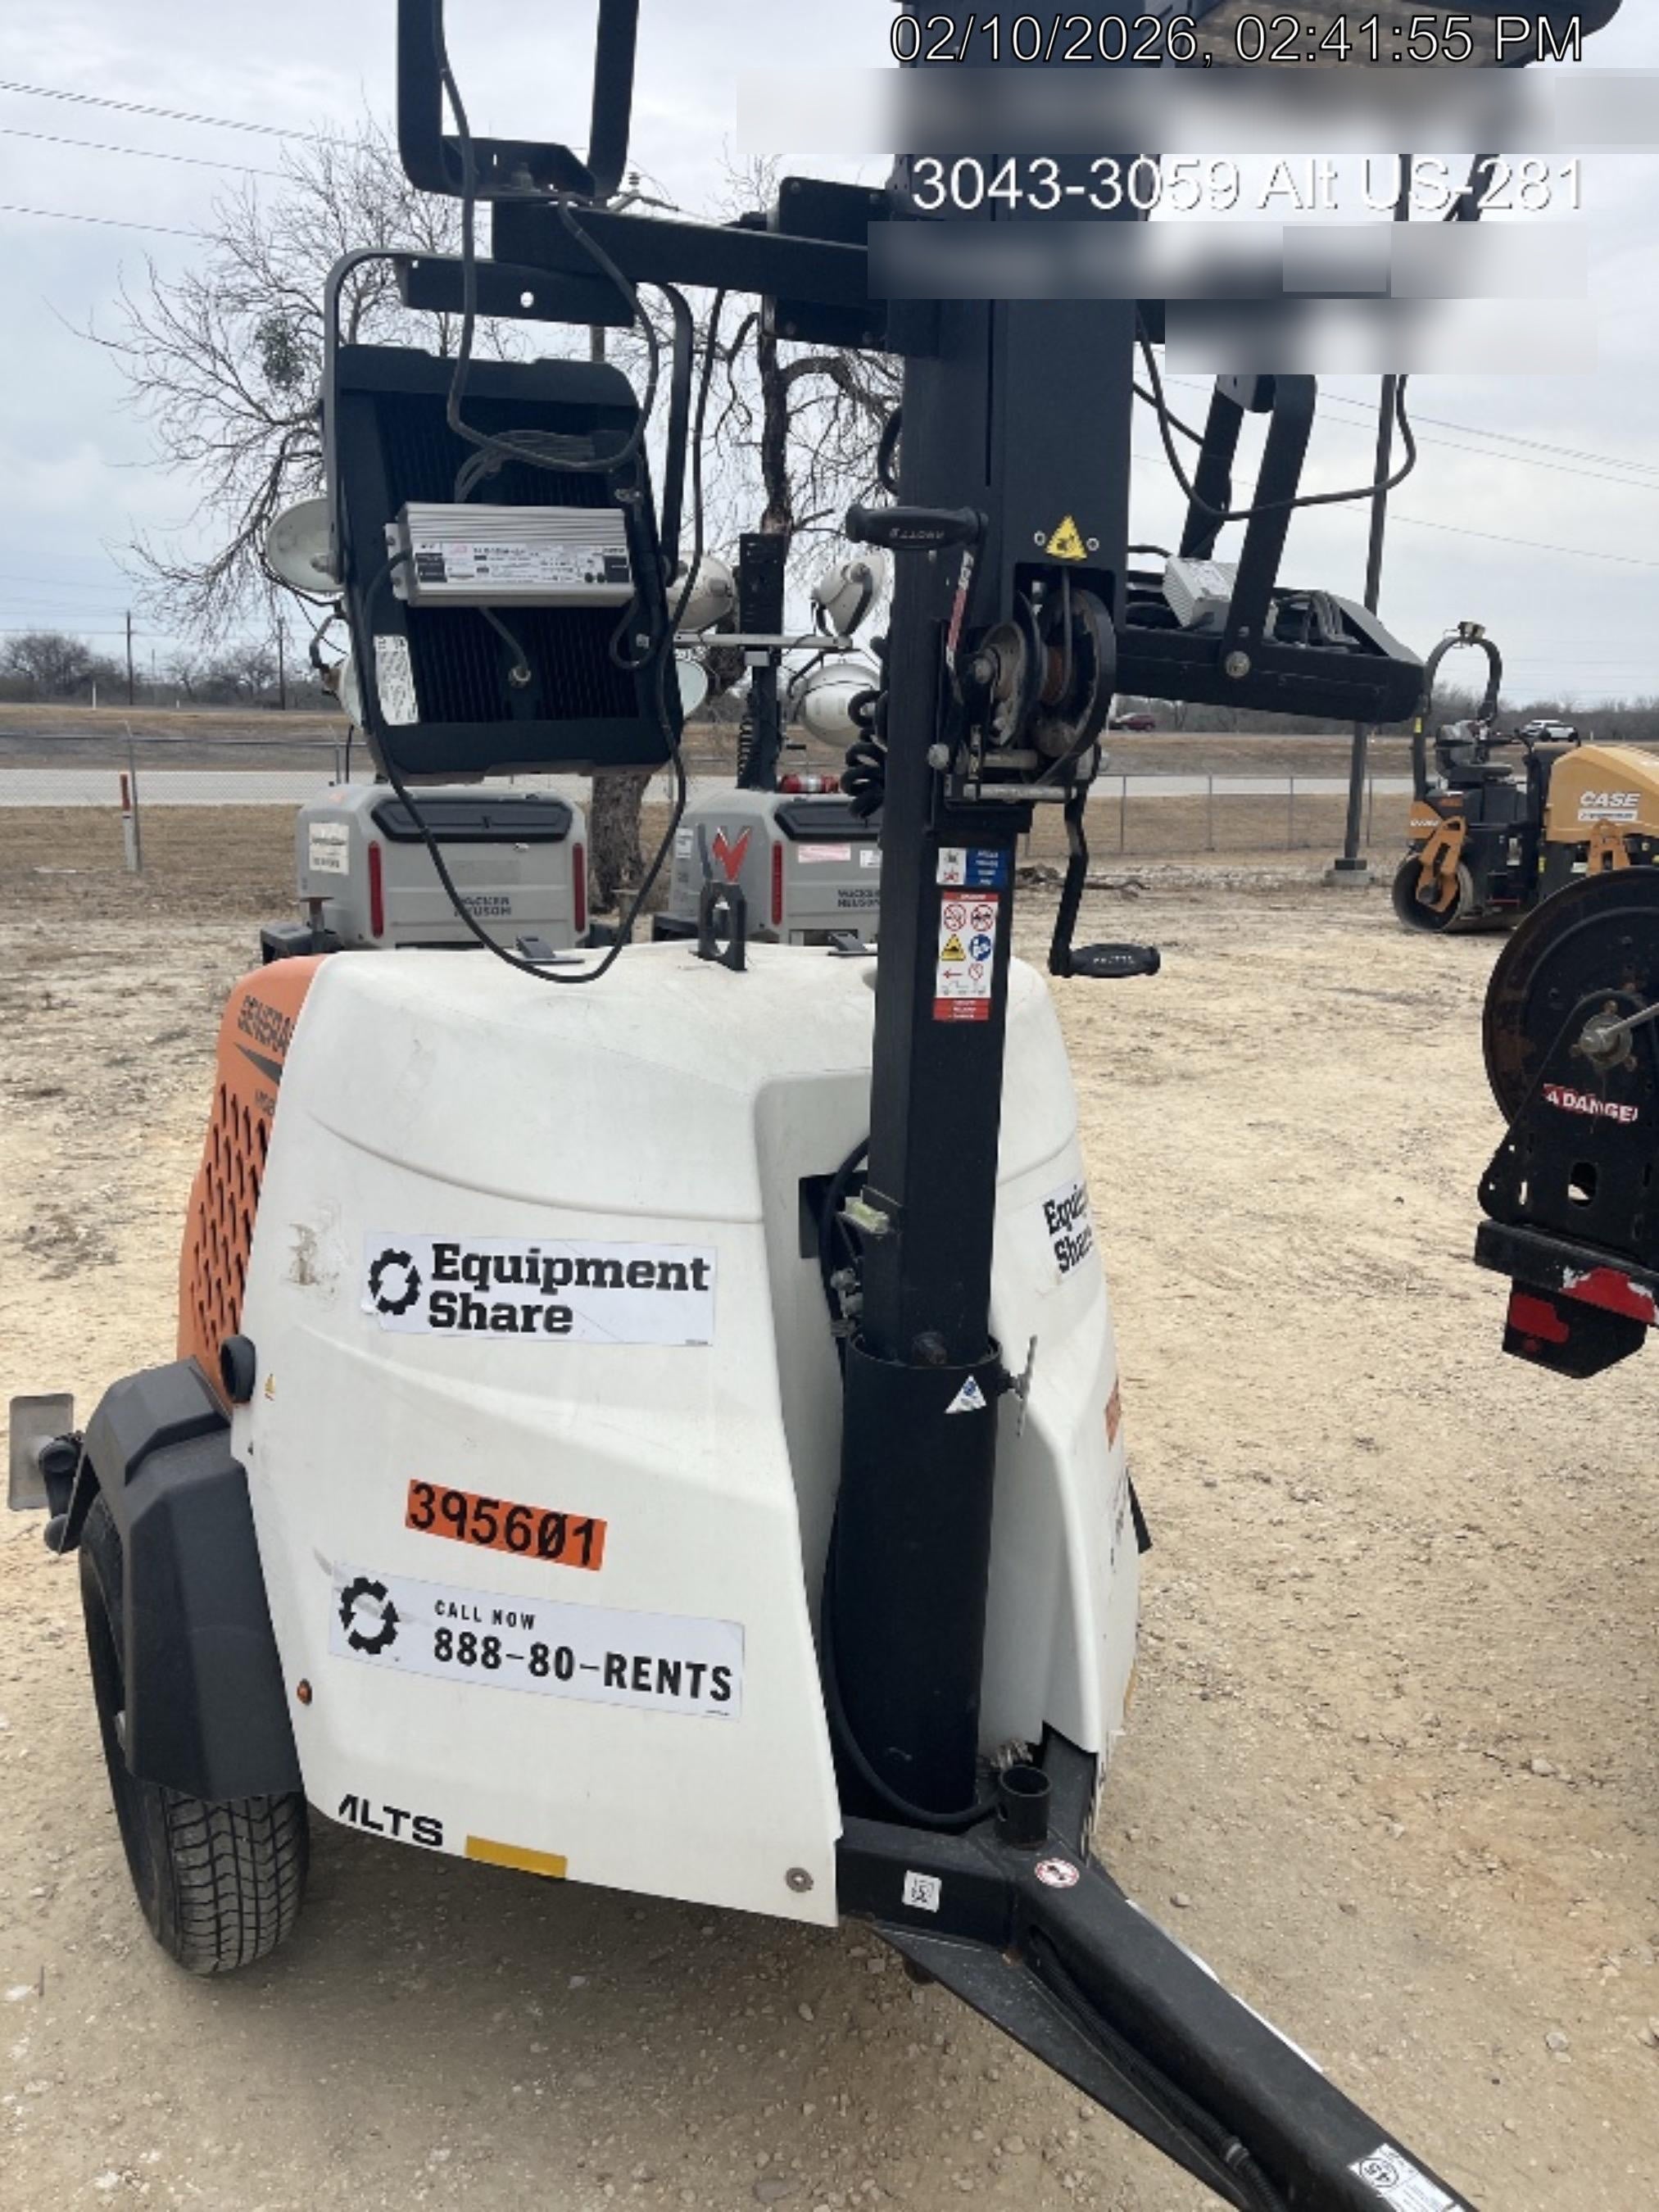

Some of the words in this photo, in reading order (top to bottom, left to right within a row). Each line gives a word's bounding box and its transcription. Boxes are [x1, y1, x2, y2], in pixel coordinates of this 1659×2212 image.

[1580, 791, 1641, 807] CASE
[431, 1243, 711, 1295] Equipment
[428, 1290, 573, 1334] Share
[410, 1482, 596, 1566] 395601
[434, 1599, 483, 1623] CALL
[491, 1609, 537, 1630] NOW
[433, 1626, 732, 1702] 888-80-RENTS
